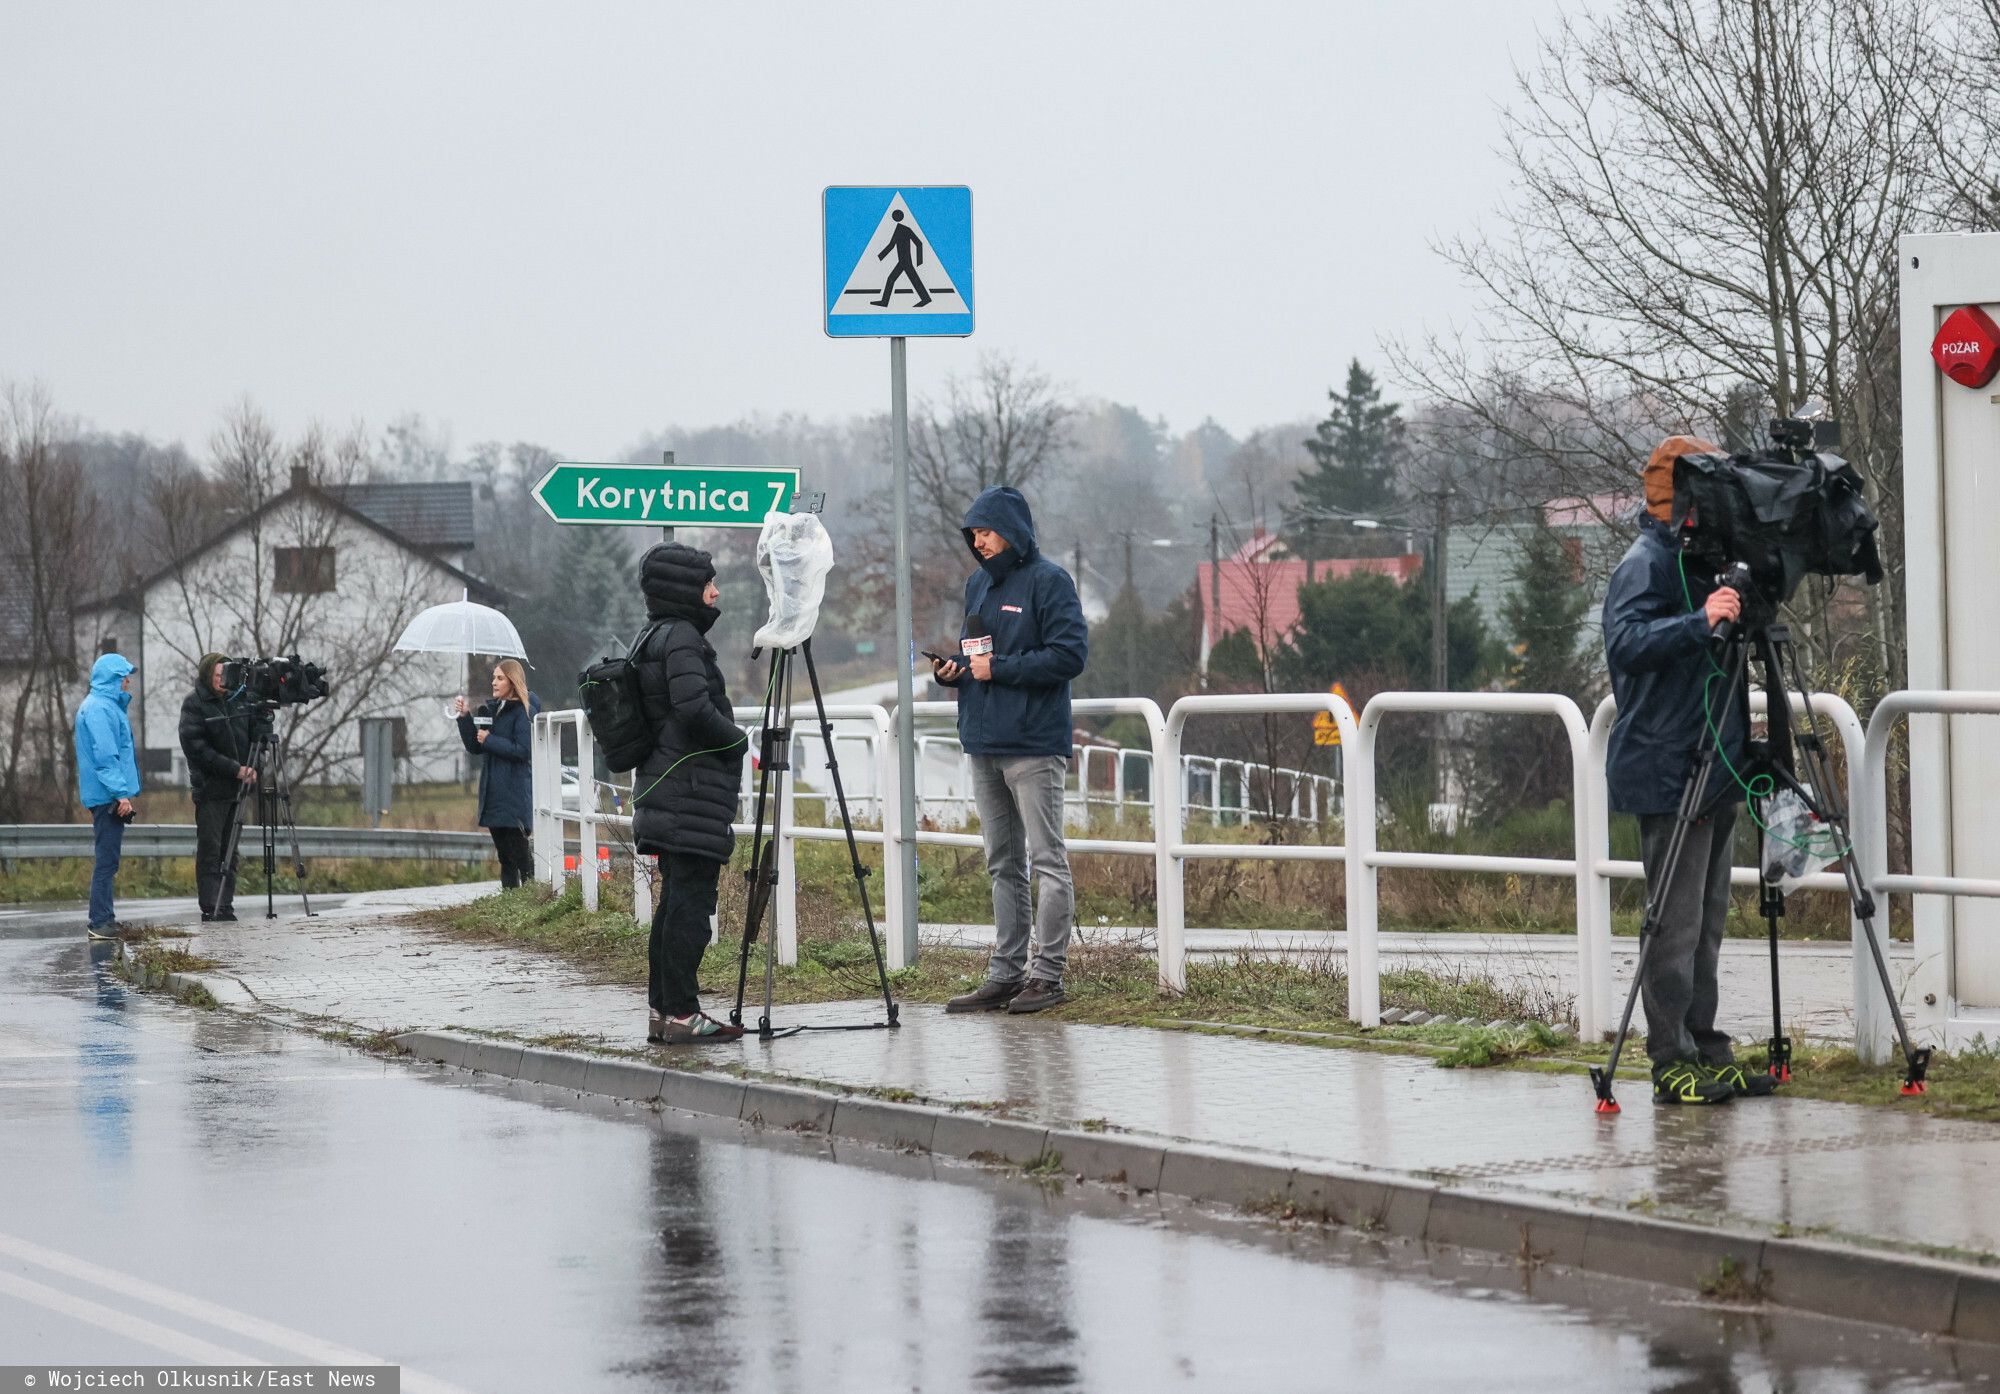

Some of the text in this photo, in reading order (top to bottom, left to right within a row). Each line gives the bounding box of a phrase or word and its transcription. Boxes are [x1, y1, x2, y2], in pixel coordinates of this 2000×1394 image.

[1942, 340, 1980, 355] POŻAR
[577, 477, 786, 519] Korytnica 7
